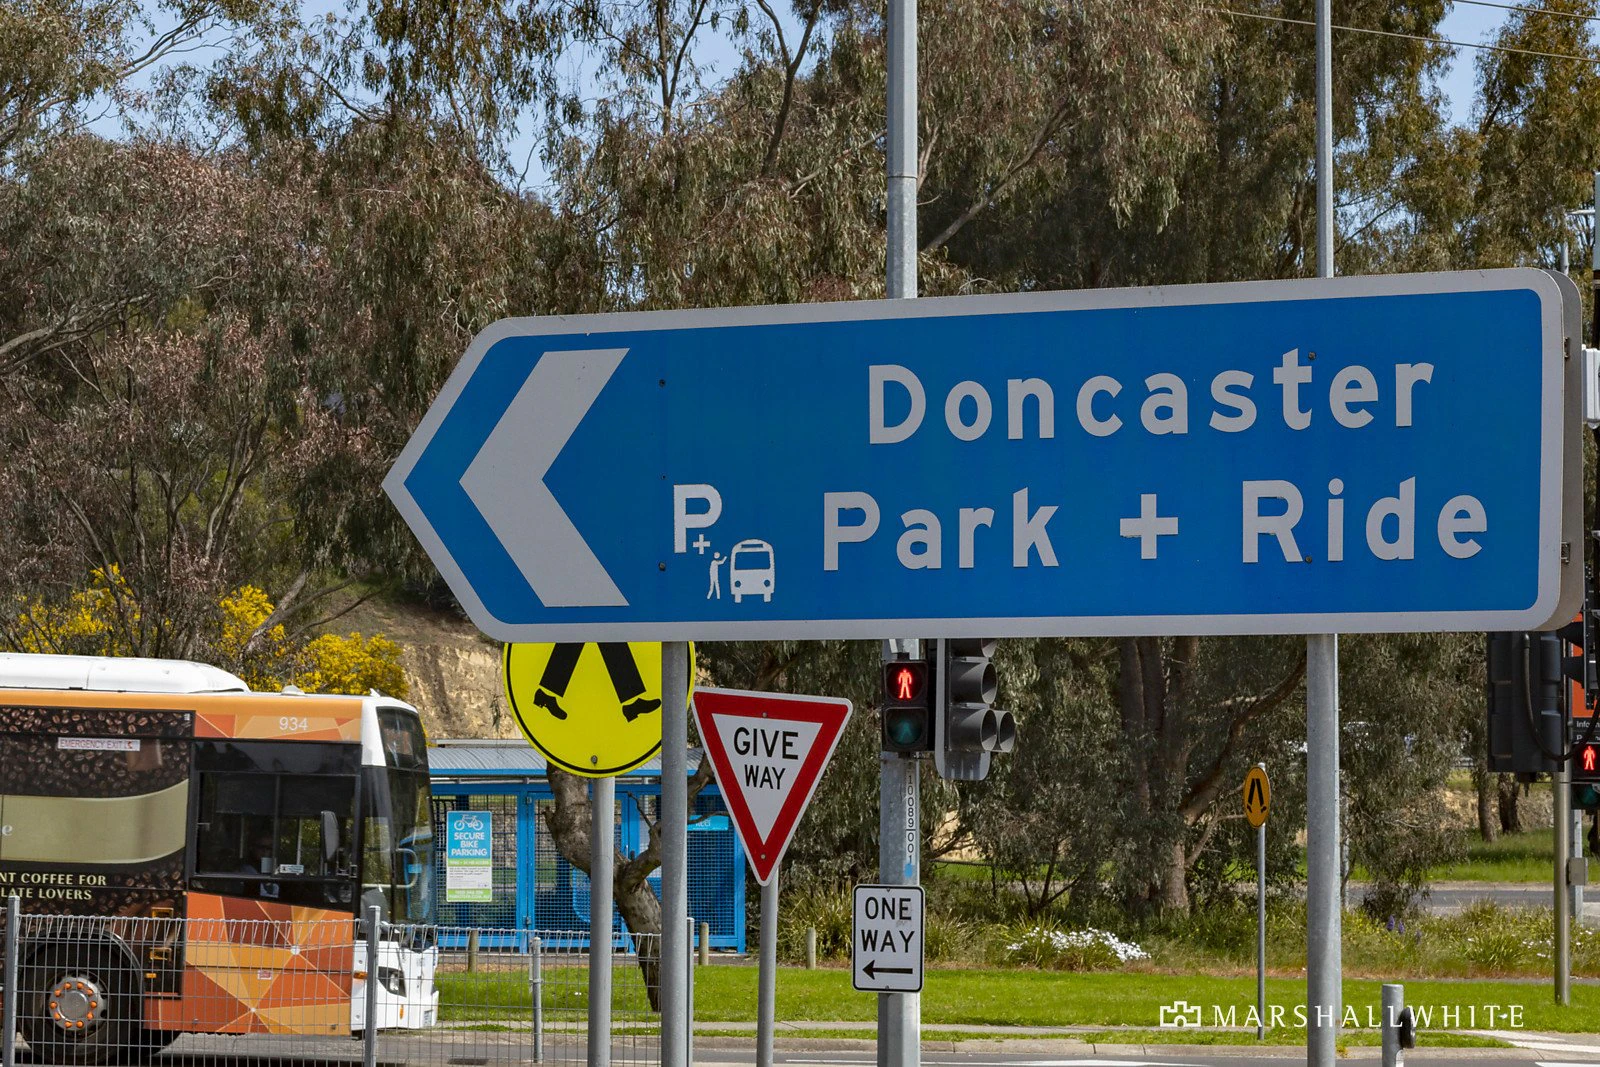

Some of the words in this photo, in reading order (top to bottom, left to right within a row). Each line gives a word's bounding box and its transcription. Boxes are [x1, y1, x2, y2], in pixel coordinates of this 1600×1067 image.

[868, 347, 1435, 445] Doncaster
[823, 487, 1060, 572] Park
[1242, 476, 1488, 564] Ride
[279, 716, 309, 731] 934
[60, 738, 105, 748] EMERGENCY
[106, 740, 122, 749] EXIT
[733, 726, 799, 760] GIVE
[744, 764, 786, 790] WAY
[454, 832, 485, 840] SECURE
[460, 840, 479, 848] BIKE
[451, 848, 487, 856] PARKING
[21, 873, 73, 885] COFFEE
[79, 875, 107, 886] FOR
[39, 888, 92, 900] LOVERS
[865, 896, 912, 920] ONE
[861, 929, 915, 953] WAY
